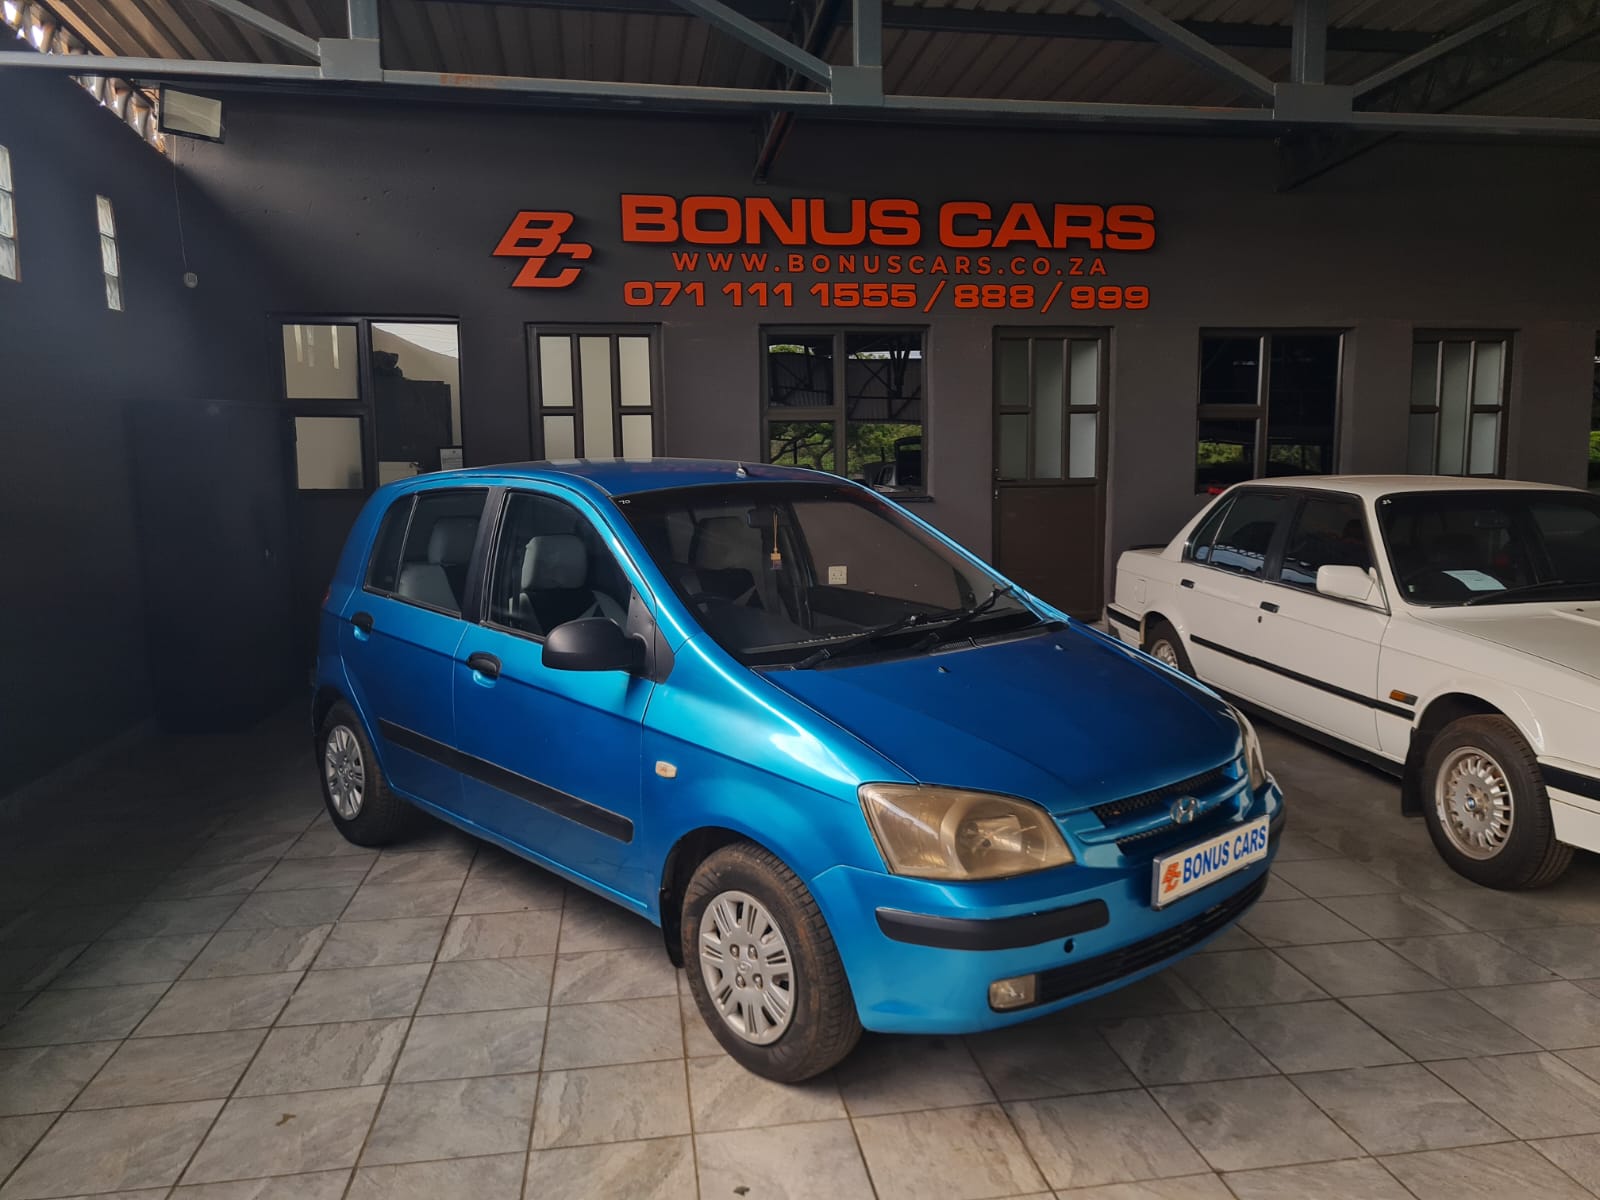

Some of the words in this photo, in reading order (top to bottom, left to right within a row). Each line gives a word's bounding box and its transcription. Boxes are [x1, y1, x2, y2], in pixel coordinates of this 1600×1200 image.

[492, 210, 593, 289] BC
[620, 193, 922, 248] BONUS
[938, 200, 1157, 252] CARS
[671, 251, 1108, 277] WWW.BONUSCARS.CO.ZA
[623, 280, 705, 308] 071
[721, 281, 794, 308] 111
[1183, 841, 1230, 883] BONUS
[1233, 825, 1267, 860] CARS
